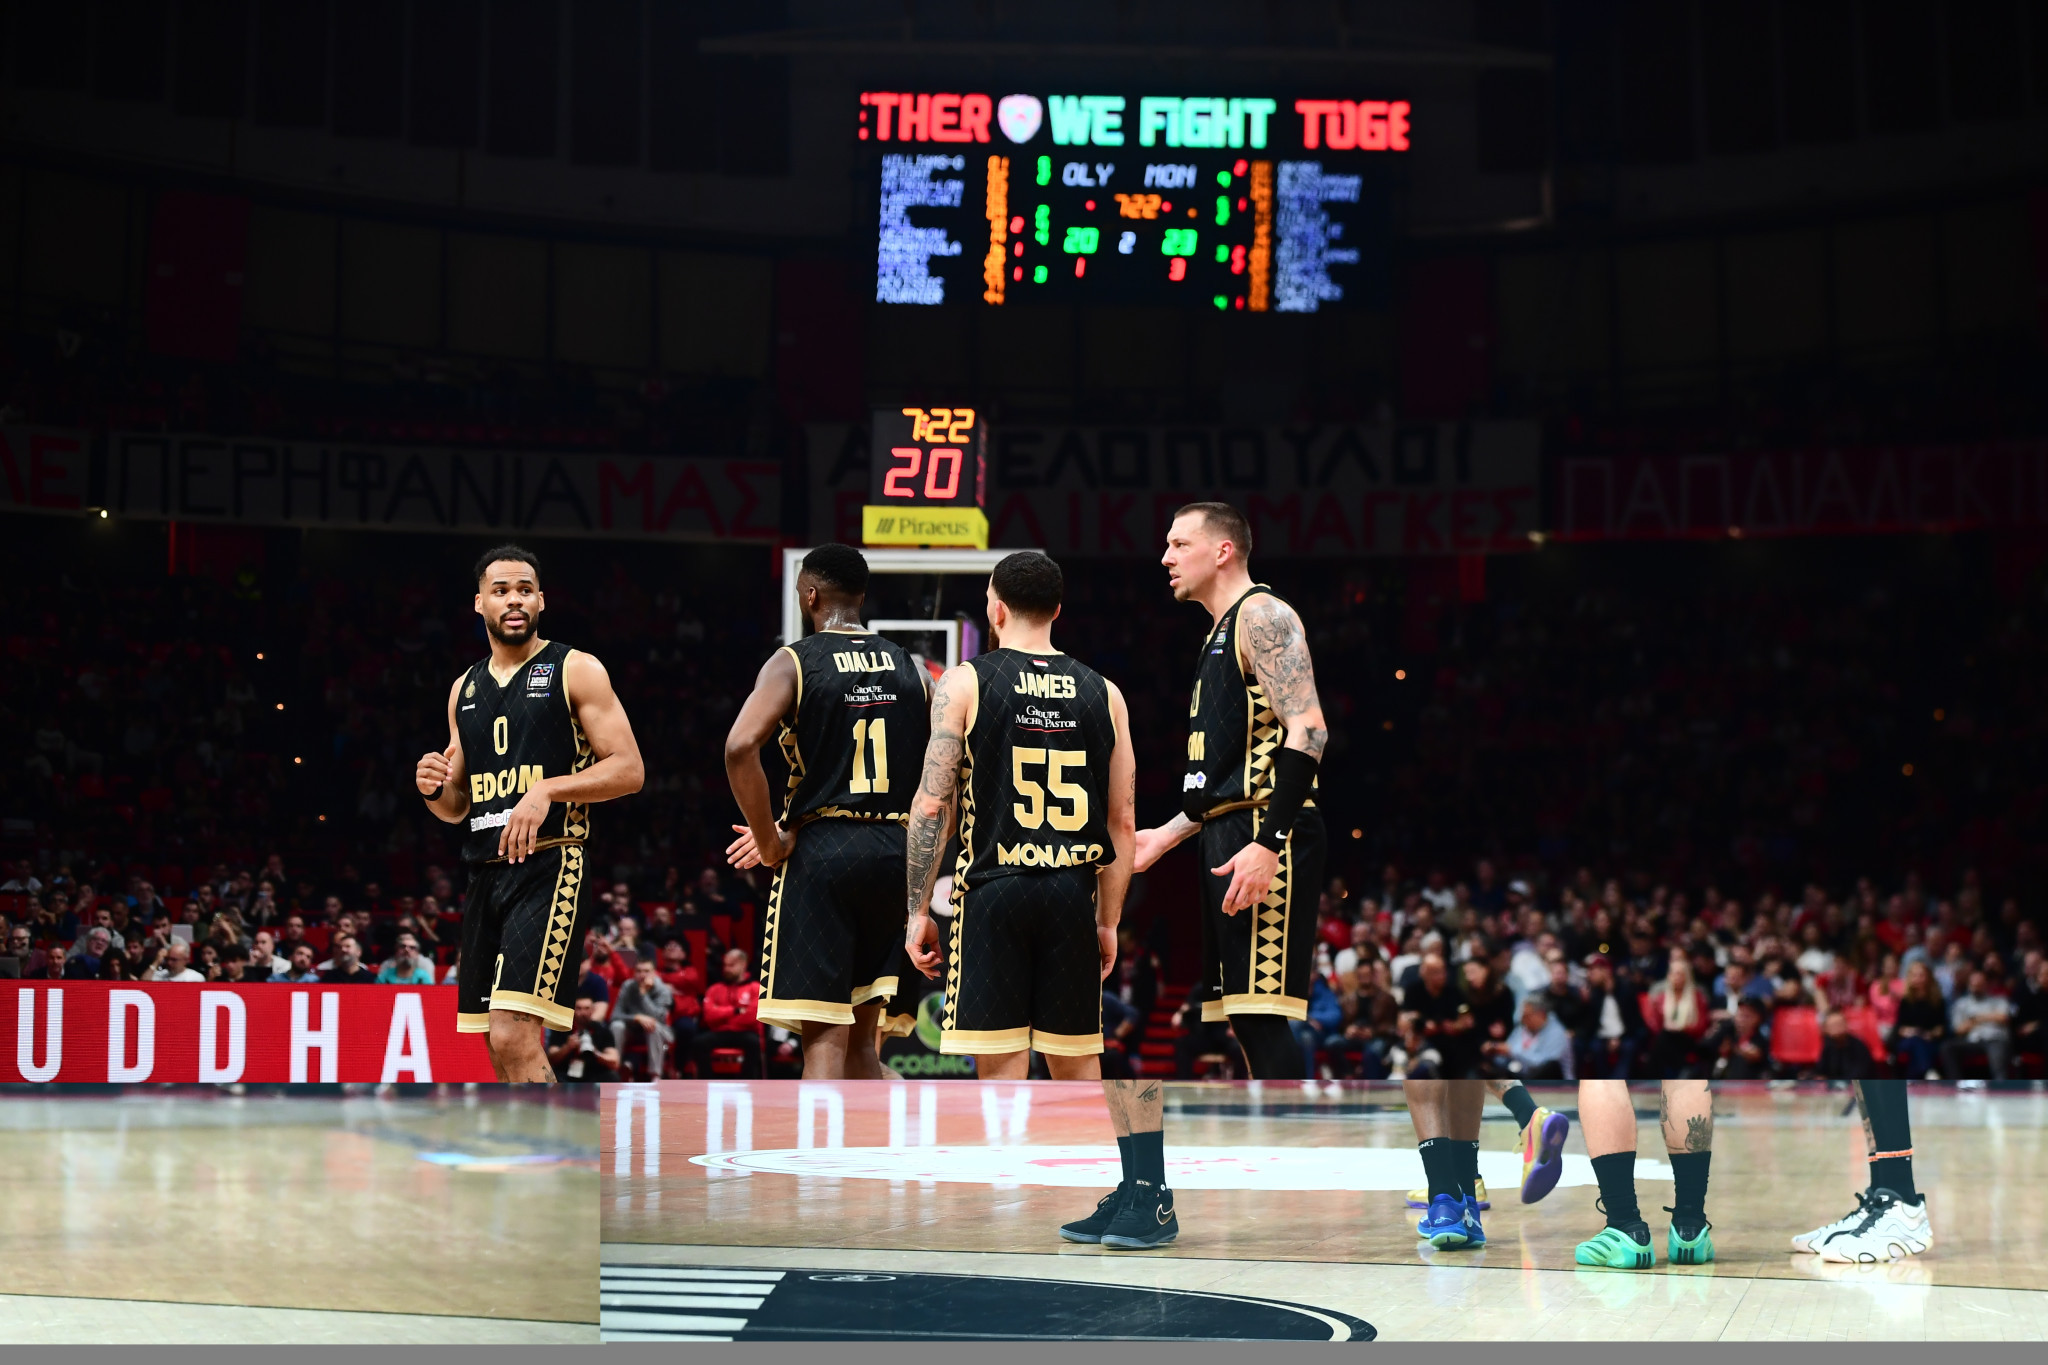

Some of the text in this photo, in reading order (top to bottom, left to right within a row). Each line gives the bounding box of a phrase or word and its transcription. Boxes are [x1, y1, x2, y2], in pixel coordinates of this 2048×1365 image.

[859, 92, 992, 143] THER
[1048, 95, 1125, 146] WE
[1139, 96, 1277, 149] FIGHT
[1062, 161, 1115, 188] OLY
[1144, 163, 1198, 189] MON
[1063, 226, 1100, 254] 20
[902, 407, 976, 443] 7:22
[883, 447, 964, 499] 20
[898, 517, 969, 535] Piraeus
[833, 651, 896, 673] DIALLO
[852, 684, 883, 694] GROUPE
[871, 692, 898, 701] PASTOR
[1014, 672, 1077, 699] JAMES
[1026, 704, 1061, 719] GROUPE
[1044, 718, 1077, 728] PASTOR
[494, 716, 509, 756] 0
[849, 717, 890, 795] 11
[1012, 746, 1088, 832] 55
[997, 842, 1104, 868] MONACO
[17, 988, 432, 1083] UDDHA
